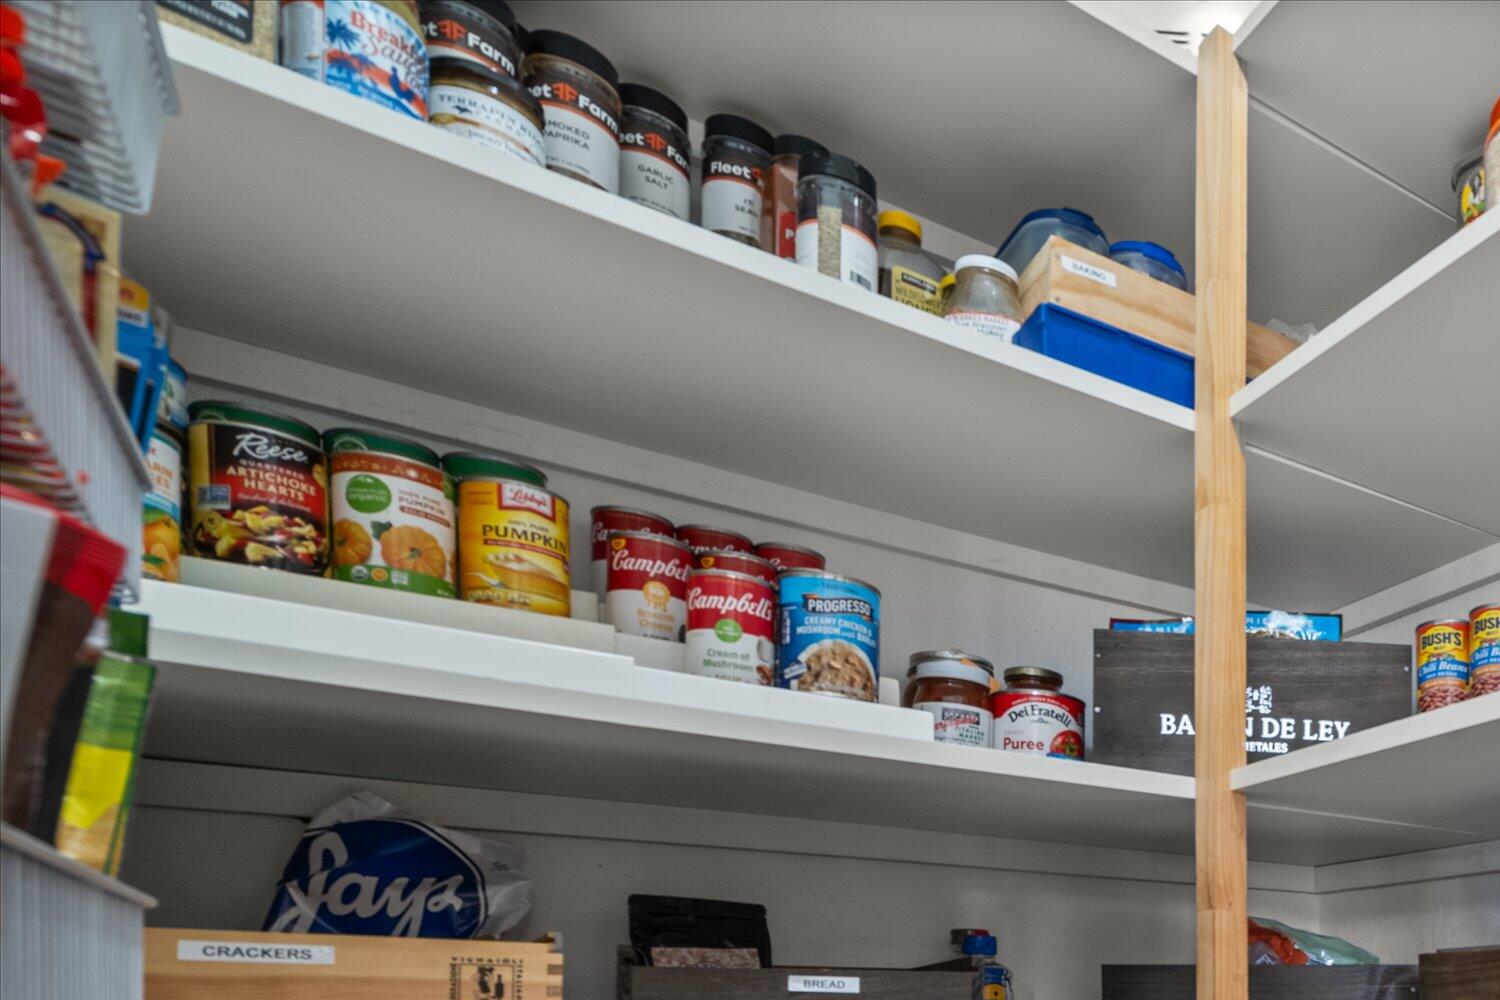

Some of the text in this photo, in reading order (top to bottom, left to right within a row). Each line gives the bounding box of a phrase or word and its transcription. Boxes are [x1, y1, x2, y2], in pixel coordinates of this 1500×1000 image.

[467, 32, 516, 76] Farm
[578, 93, 619, 133] Farm
[546, 119, 591, 140] MOKED
[637, 163, 675, 186] GARLIC
[711, 160, 750, 178] Fleet
[644, 175, 669, 191] SALT
[1071, 261, 1107, 281] BAKING
[232, 432, 308, 463] Reese
[239, 459, 305, 481] QUARTERED
[226, 465, 317, 497] ARTICHOKE
[244, 478, 305, 502] HEARTS
[482, 524, 568, 554] PUMPKIN
[612, 551, 690, 581] Campbel
[807, 598, 872, 616] PROGRESSO
[1421, 631, 1462, 650] BUSH'S
[706, 648, 751, 661] Cream of
[703, 659, 754, 672] Mushroom
[1438, 661, 1468, 673] Beans
[1008, 704, 1072, 728] Dei Fratelli
[1261, 717, 1297, 739] DE
[1303, 719, 1351, 742] LEY
[1003, 737, 1045, 751] Puree
[202, 944, 313, 962] CRACKERS
[802, 978, 846, 991] BREAD
